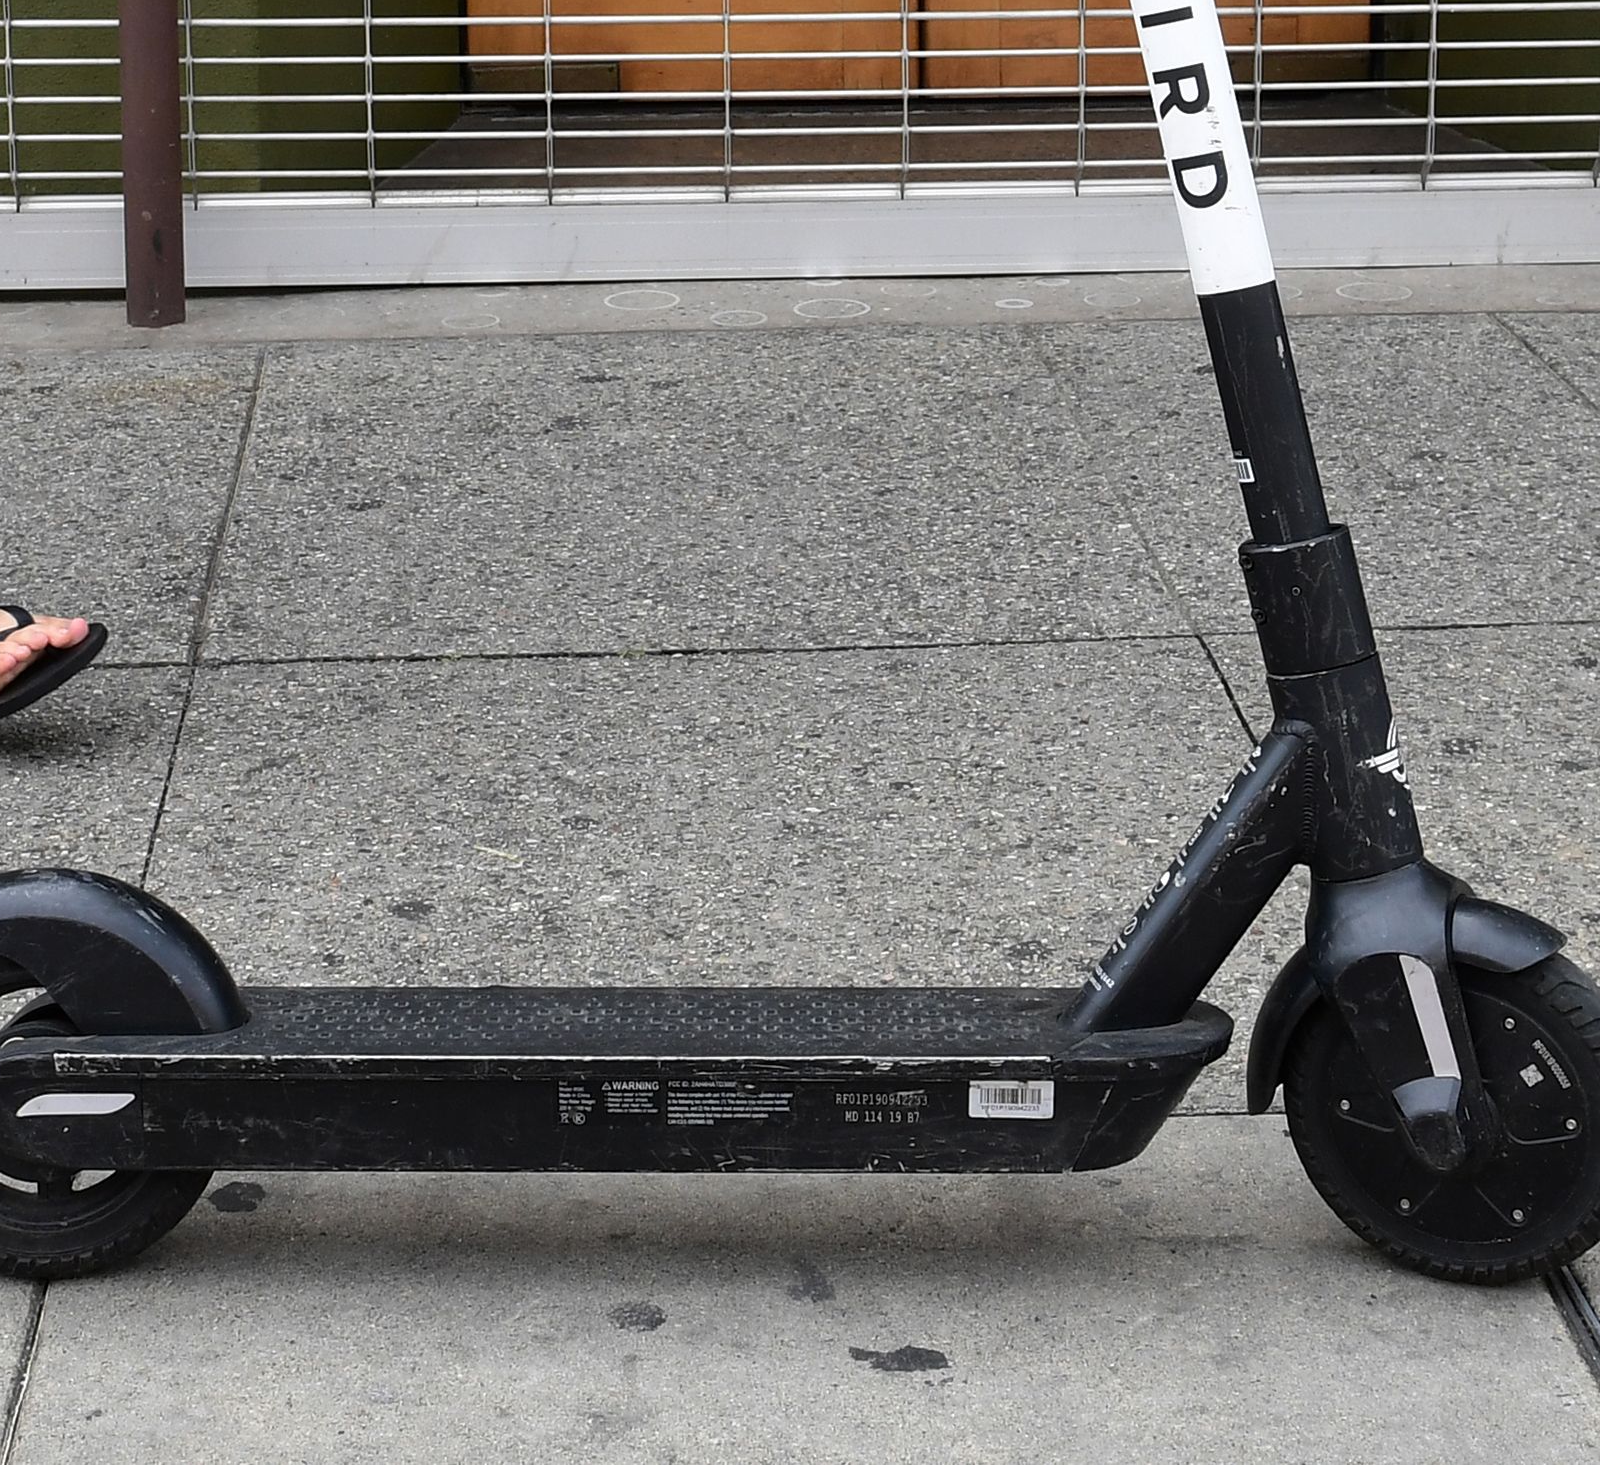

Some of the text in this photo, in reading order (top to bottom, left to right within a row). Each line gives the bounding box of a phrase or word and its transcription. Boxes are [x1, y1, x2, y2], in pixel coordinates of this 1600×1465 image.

[612, 1081, 660, 1090] WARNING
[864, 1111, 882, 1122] 114
[890, 1111, 901, 1123] 19
